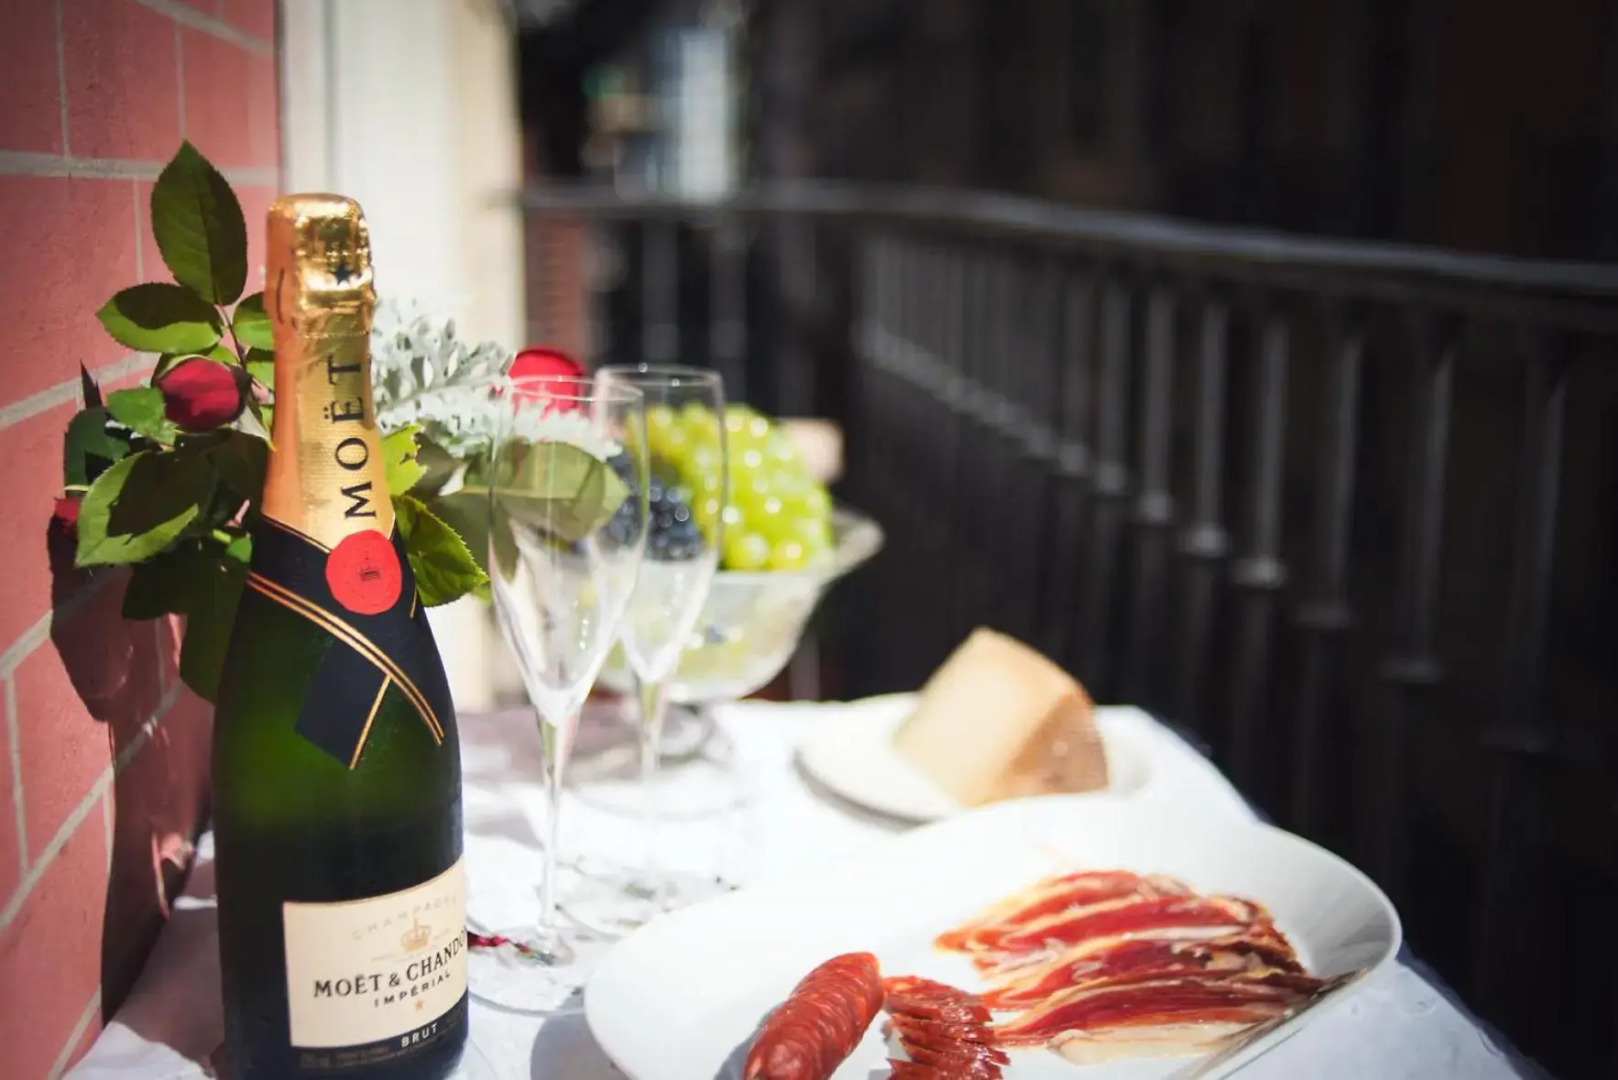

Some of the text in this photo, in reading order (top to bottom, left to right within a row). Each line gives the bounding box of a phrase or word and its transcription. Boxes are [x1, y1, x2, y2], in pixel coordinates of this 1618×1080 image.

[323, 354, 377, 519] MOËT
[313, 973, 384, 998] MOËT
[388, 973, 401, 987] &
[406, 926, 467, 981] CHANDO
[374, 970, 451, 1008] IMPÉRIAL
[401, 1022, 438, 1048] BRUT
